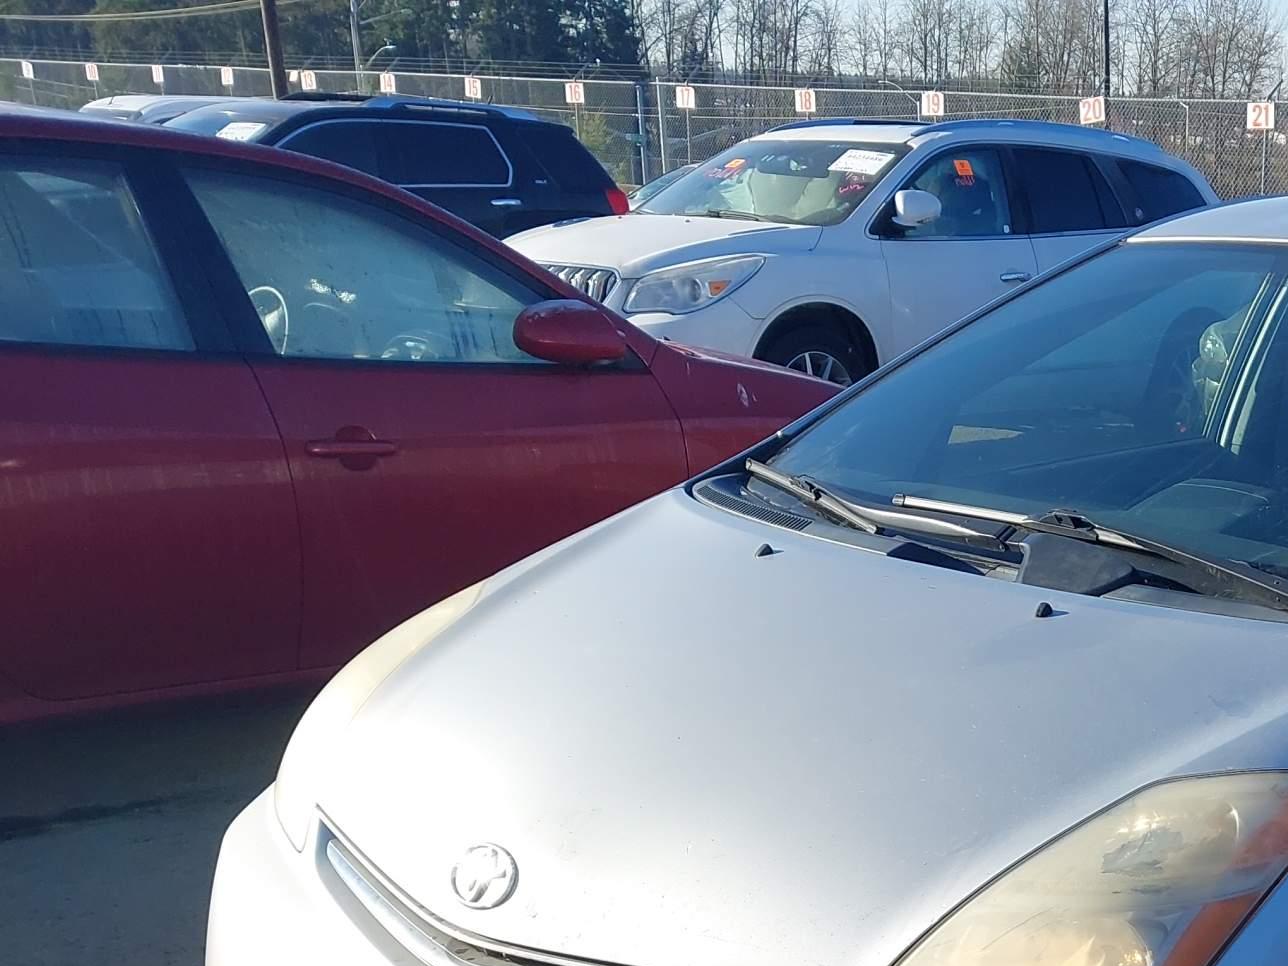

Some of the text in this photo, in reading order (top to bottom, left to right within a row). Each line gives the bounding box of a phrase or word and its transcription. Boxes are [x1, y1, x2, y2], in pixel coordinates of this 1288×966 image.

[302, 72, 313, 88] 13
[382, 74, 393, 91] 14
[467, 78, 478, 97] 15
[568, 84, 580, 102] 16
[680, 88, 690, 106] 17
[799, 91, 811, 110] 18
[926, 93, 940, 113] 19
[1081, 98, 1102, 122] 20
[1252, 104, 1269, 127] 21
